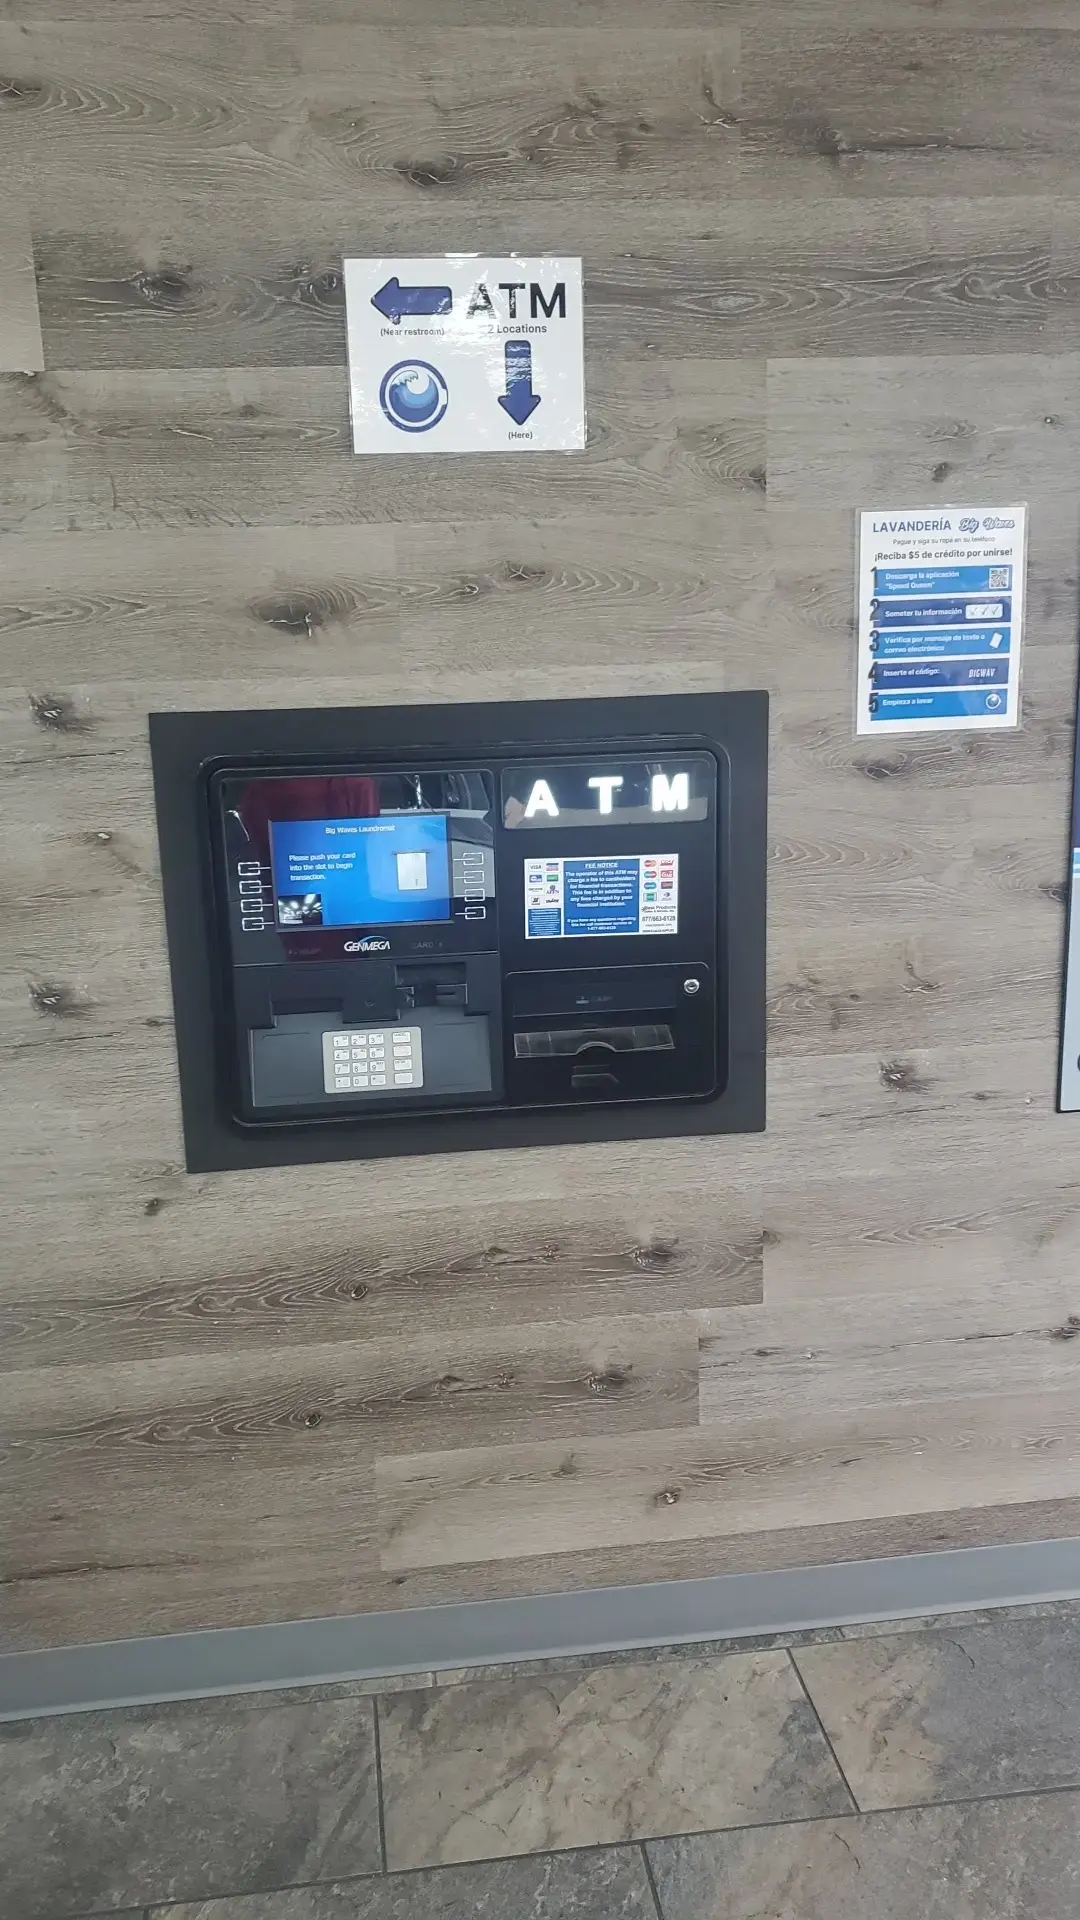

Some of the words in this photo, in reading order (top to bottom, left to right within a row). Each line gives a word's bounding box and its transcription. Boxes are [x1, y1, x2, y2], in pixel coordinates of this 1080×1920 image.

[466, 282, 566, 319] ATM
[380, 327, 402, 337] (Near
[404, 327, 445, 336] restroom)
[497, 324, 547, 334] Locations
[508, 431, 533, 440] (Here)
[873, 517, 951, 533] LAVANDERÍA
[959, 518, 979, 533] Big
[875, 552, 906, 561] ¡Reciba
[909, 551, 919, 559] $5
[922, 550, 932, 558] de
[934, 549, 965, 558] crédito
[967, 550, 981, 558] por
[984, 548, 1012, 557] unirse!
[870, 566, 878, 590] 1
[926, 571, 959, 579] aplicación
[870, 598, 880, 621] 2
[869, 630, 880, 652] 3
[868, 662, 878, 682] 4
[869, 692, 878, 714] 5
[344, 940, 390, 952] GENMEGA
